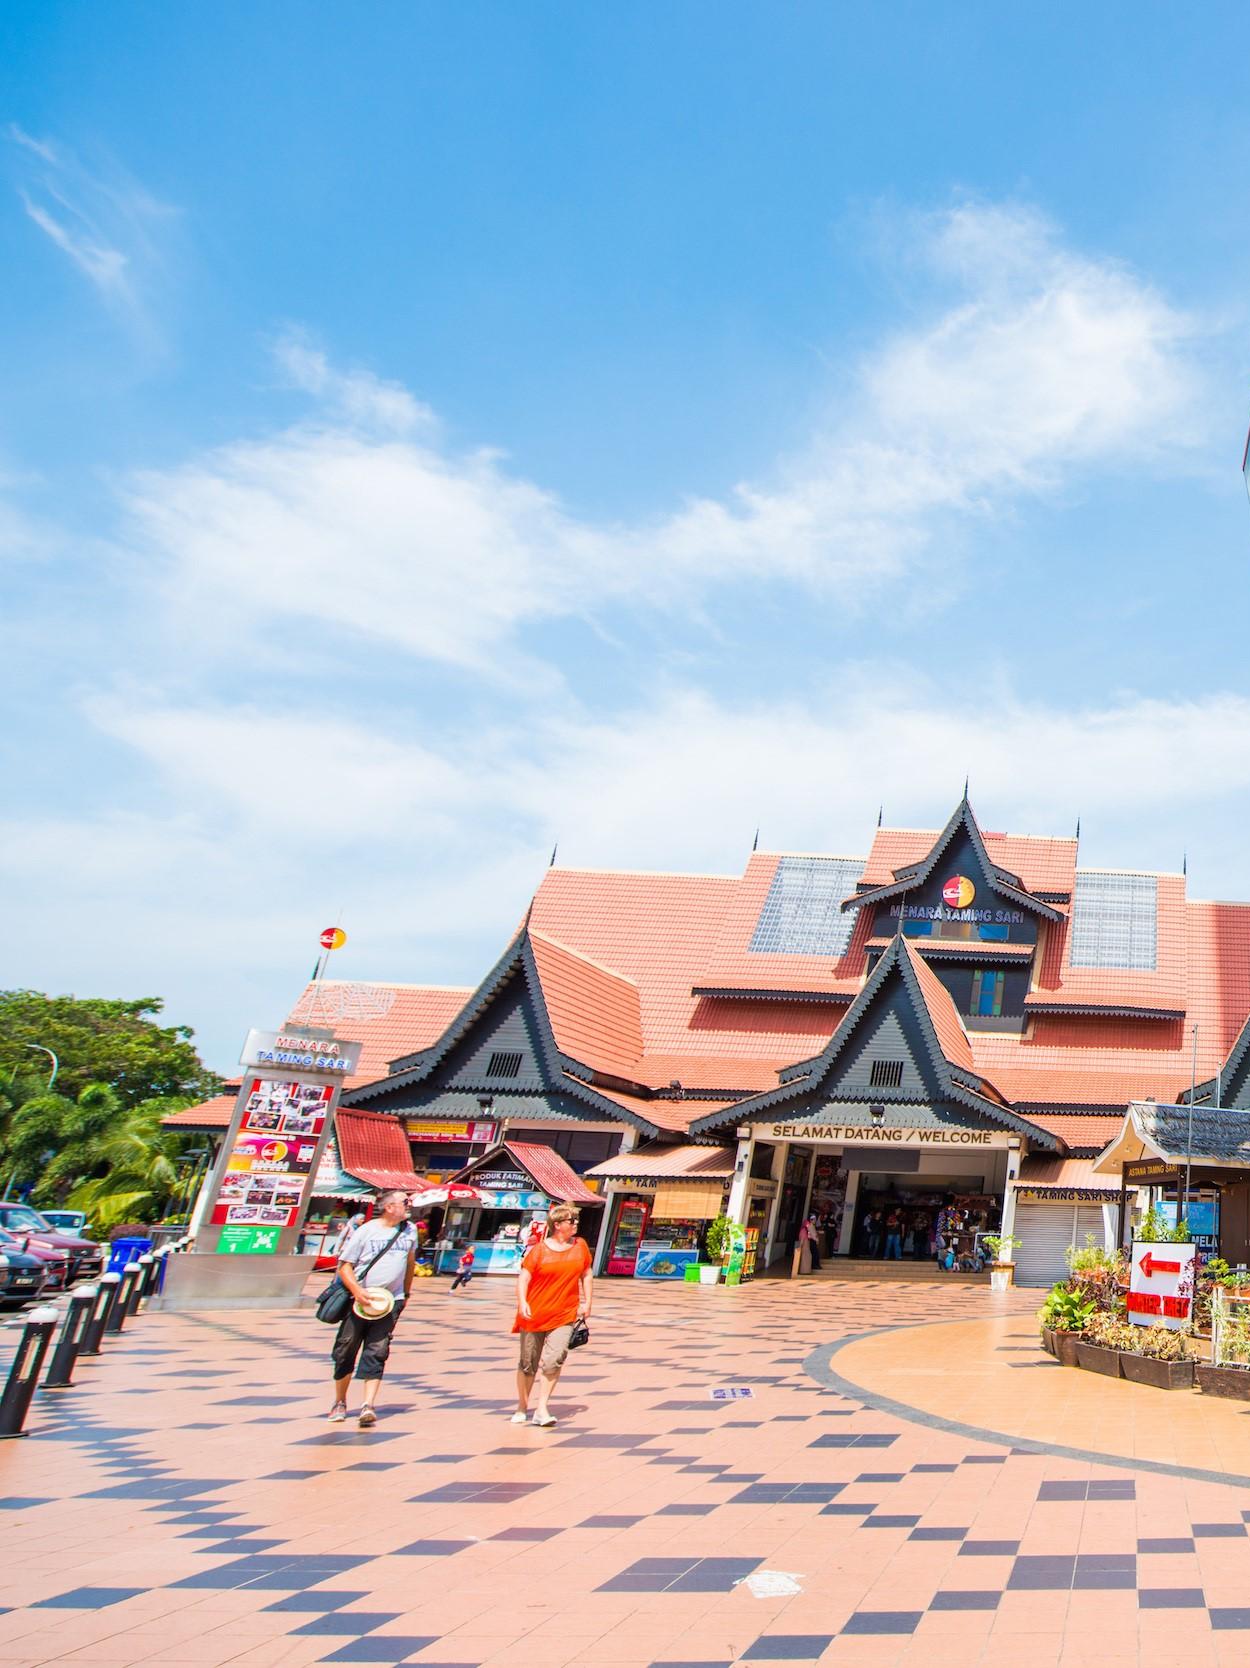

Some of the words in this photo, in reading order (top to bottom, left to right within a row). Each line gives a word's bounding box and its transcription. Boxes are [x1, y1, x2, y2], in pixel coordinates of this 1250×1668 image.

[890, 904, 942, 920] MENARA
[945, 907, 992, 922] TAMING
[994, 910, 1024, 924] SARI
[276, 1037, 341, 1054] MENARA
[257, 1050, 313, 1066] TAMING
[316, 1056, 351, 1070] SARI
[772, 1125, 841, 1138] SELAMAT
[844, 1127, 903, 1141] DATANG
[905, 1131, 915, 1142] /
[918, 1131, 992, 1144] WELCOME
[470, 1173, 501, 1181] PRODUK
[1036, 1190, 1075, 1201] TAMING
[1077, 1191, 1102, 1202] SARI
